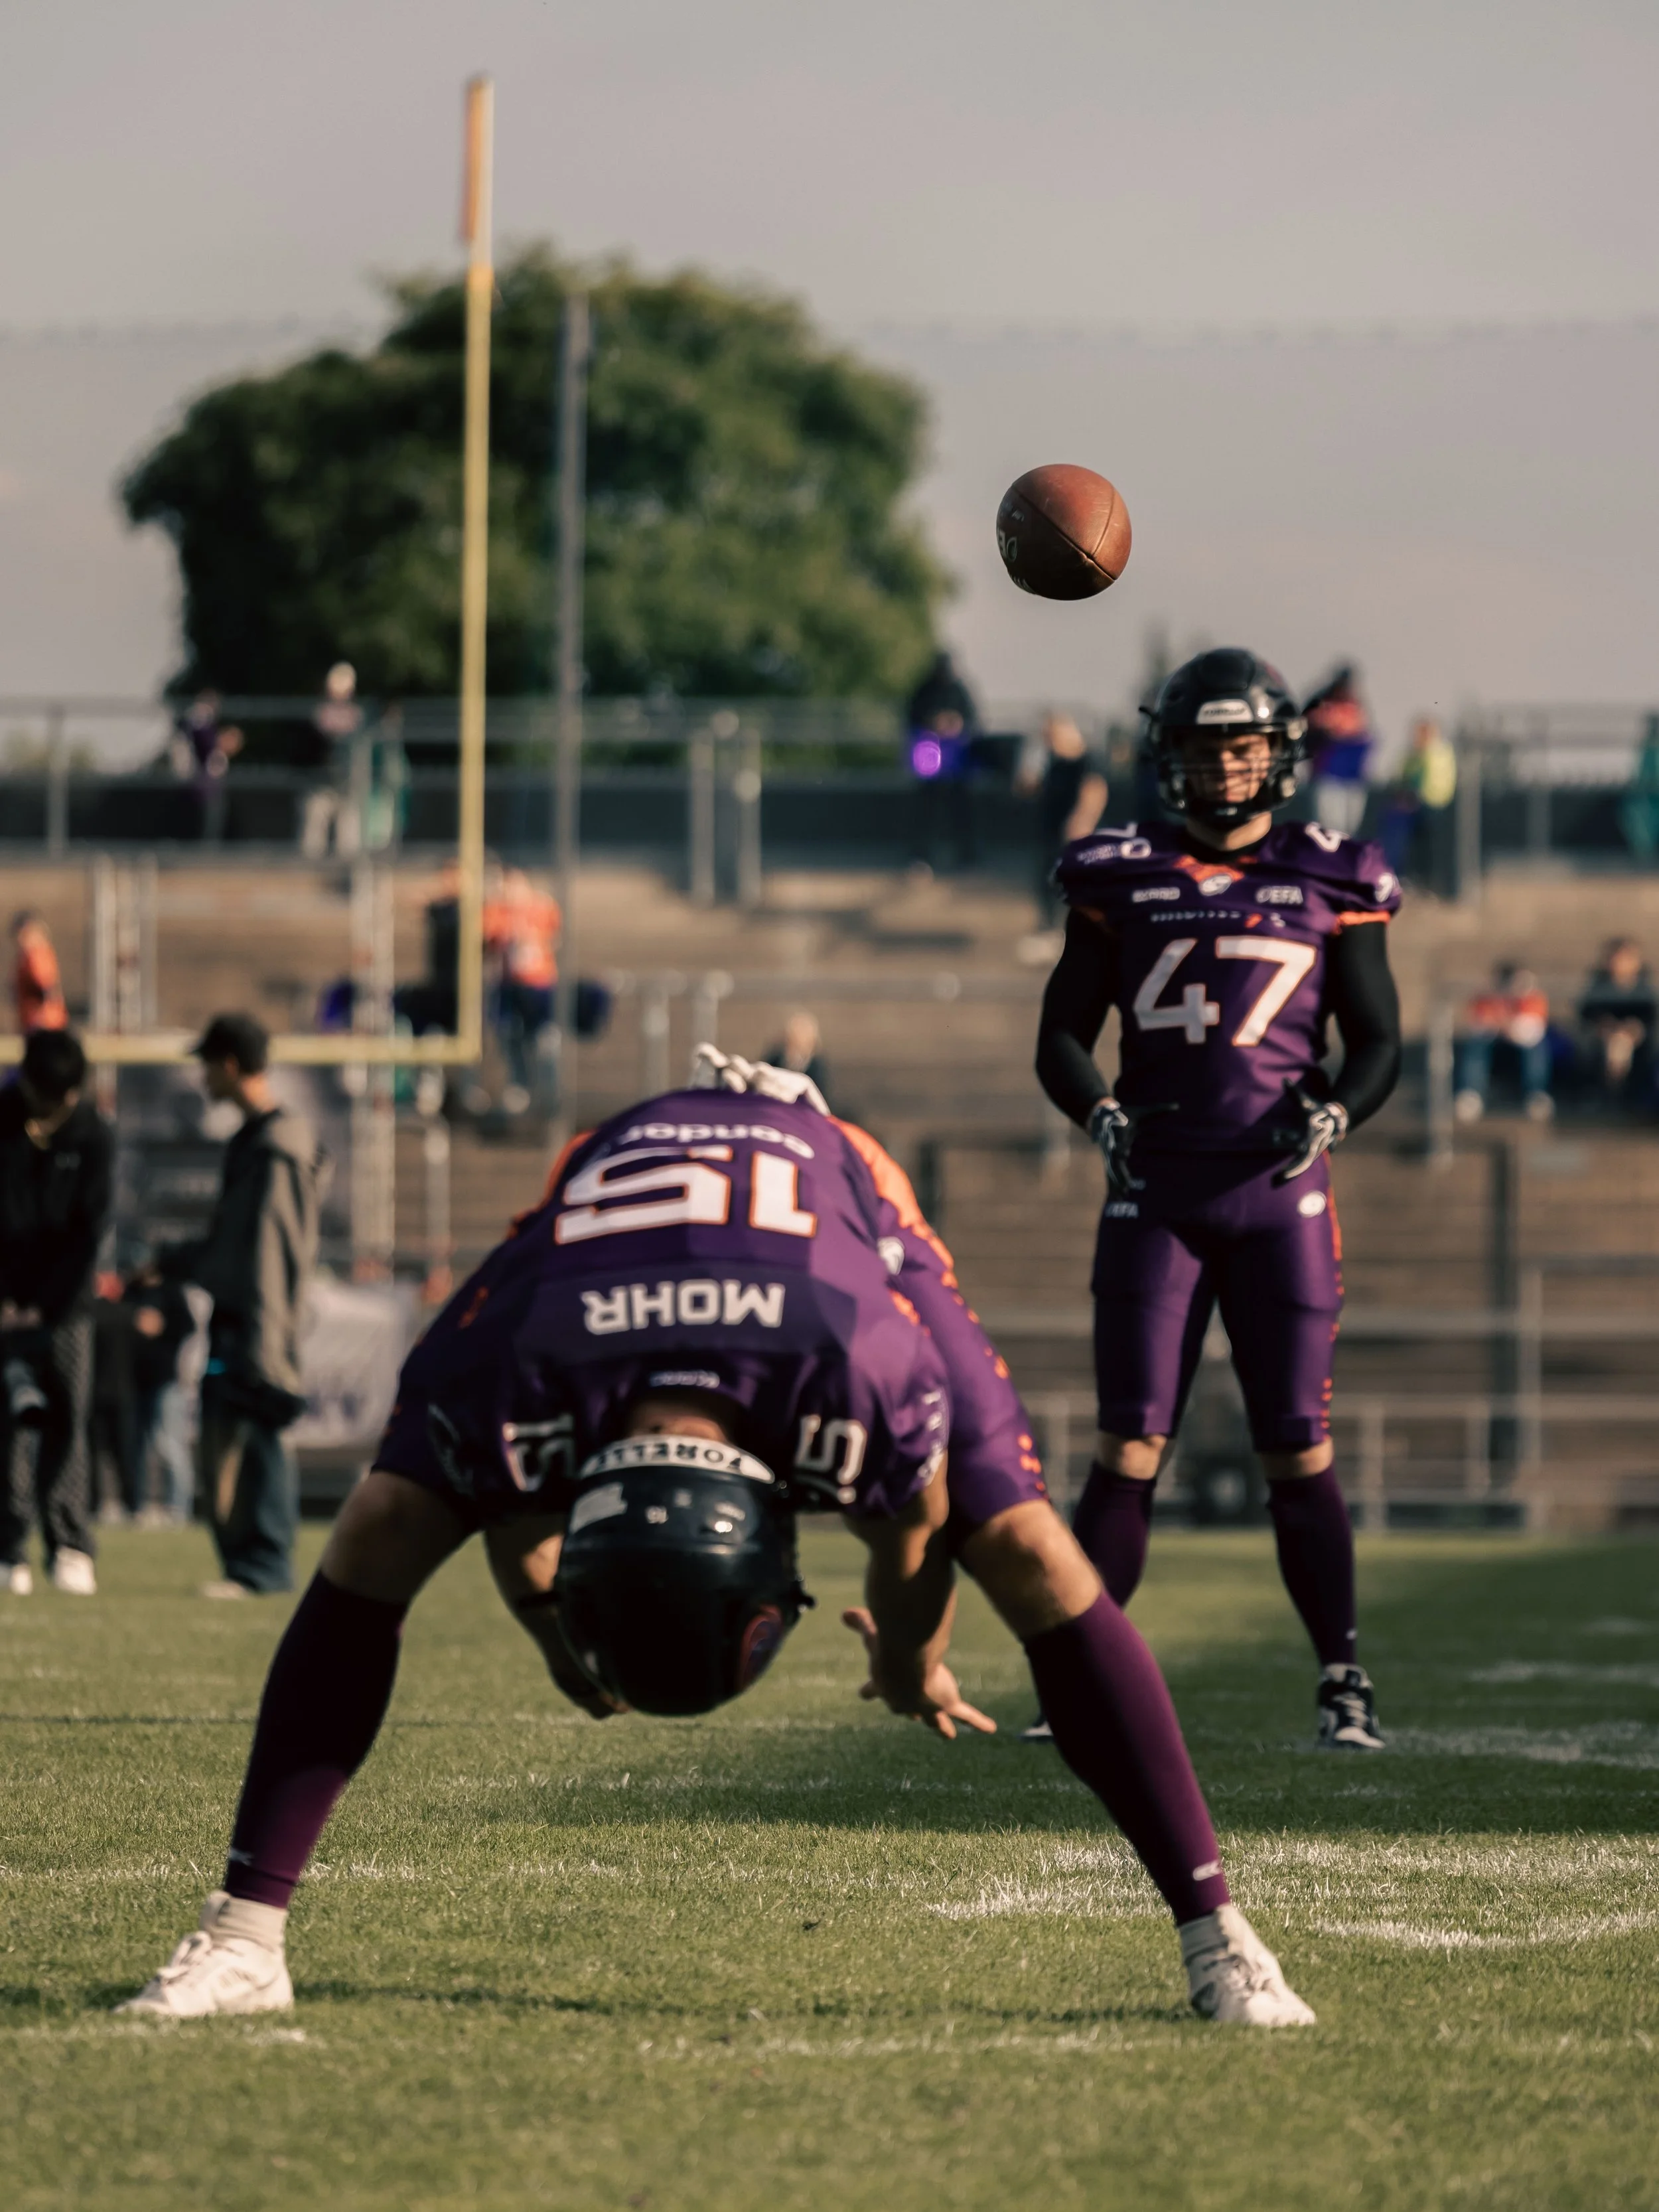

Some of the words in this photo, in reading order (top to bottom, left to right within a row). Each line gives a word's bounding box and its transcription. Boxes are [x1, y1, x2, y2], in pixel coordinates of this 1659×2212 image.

[1132, 936, 1317, 1047] 47
[555, 1145, 818, 1245] 15
[581, 1279, 786, 1335] MOHR
